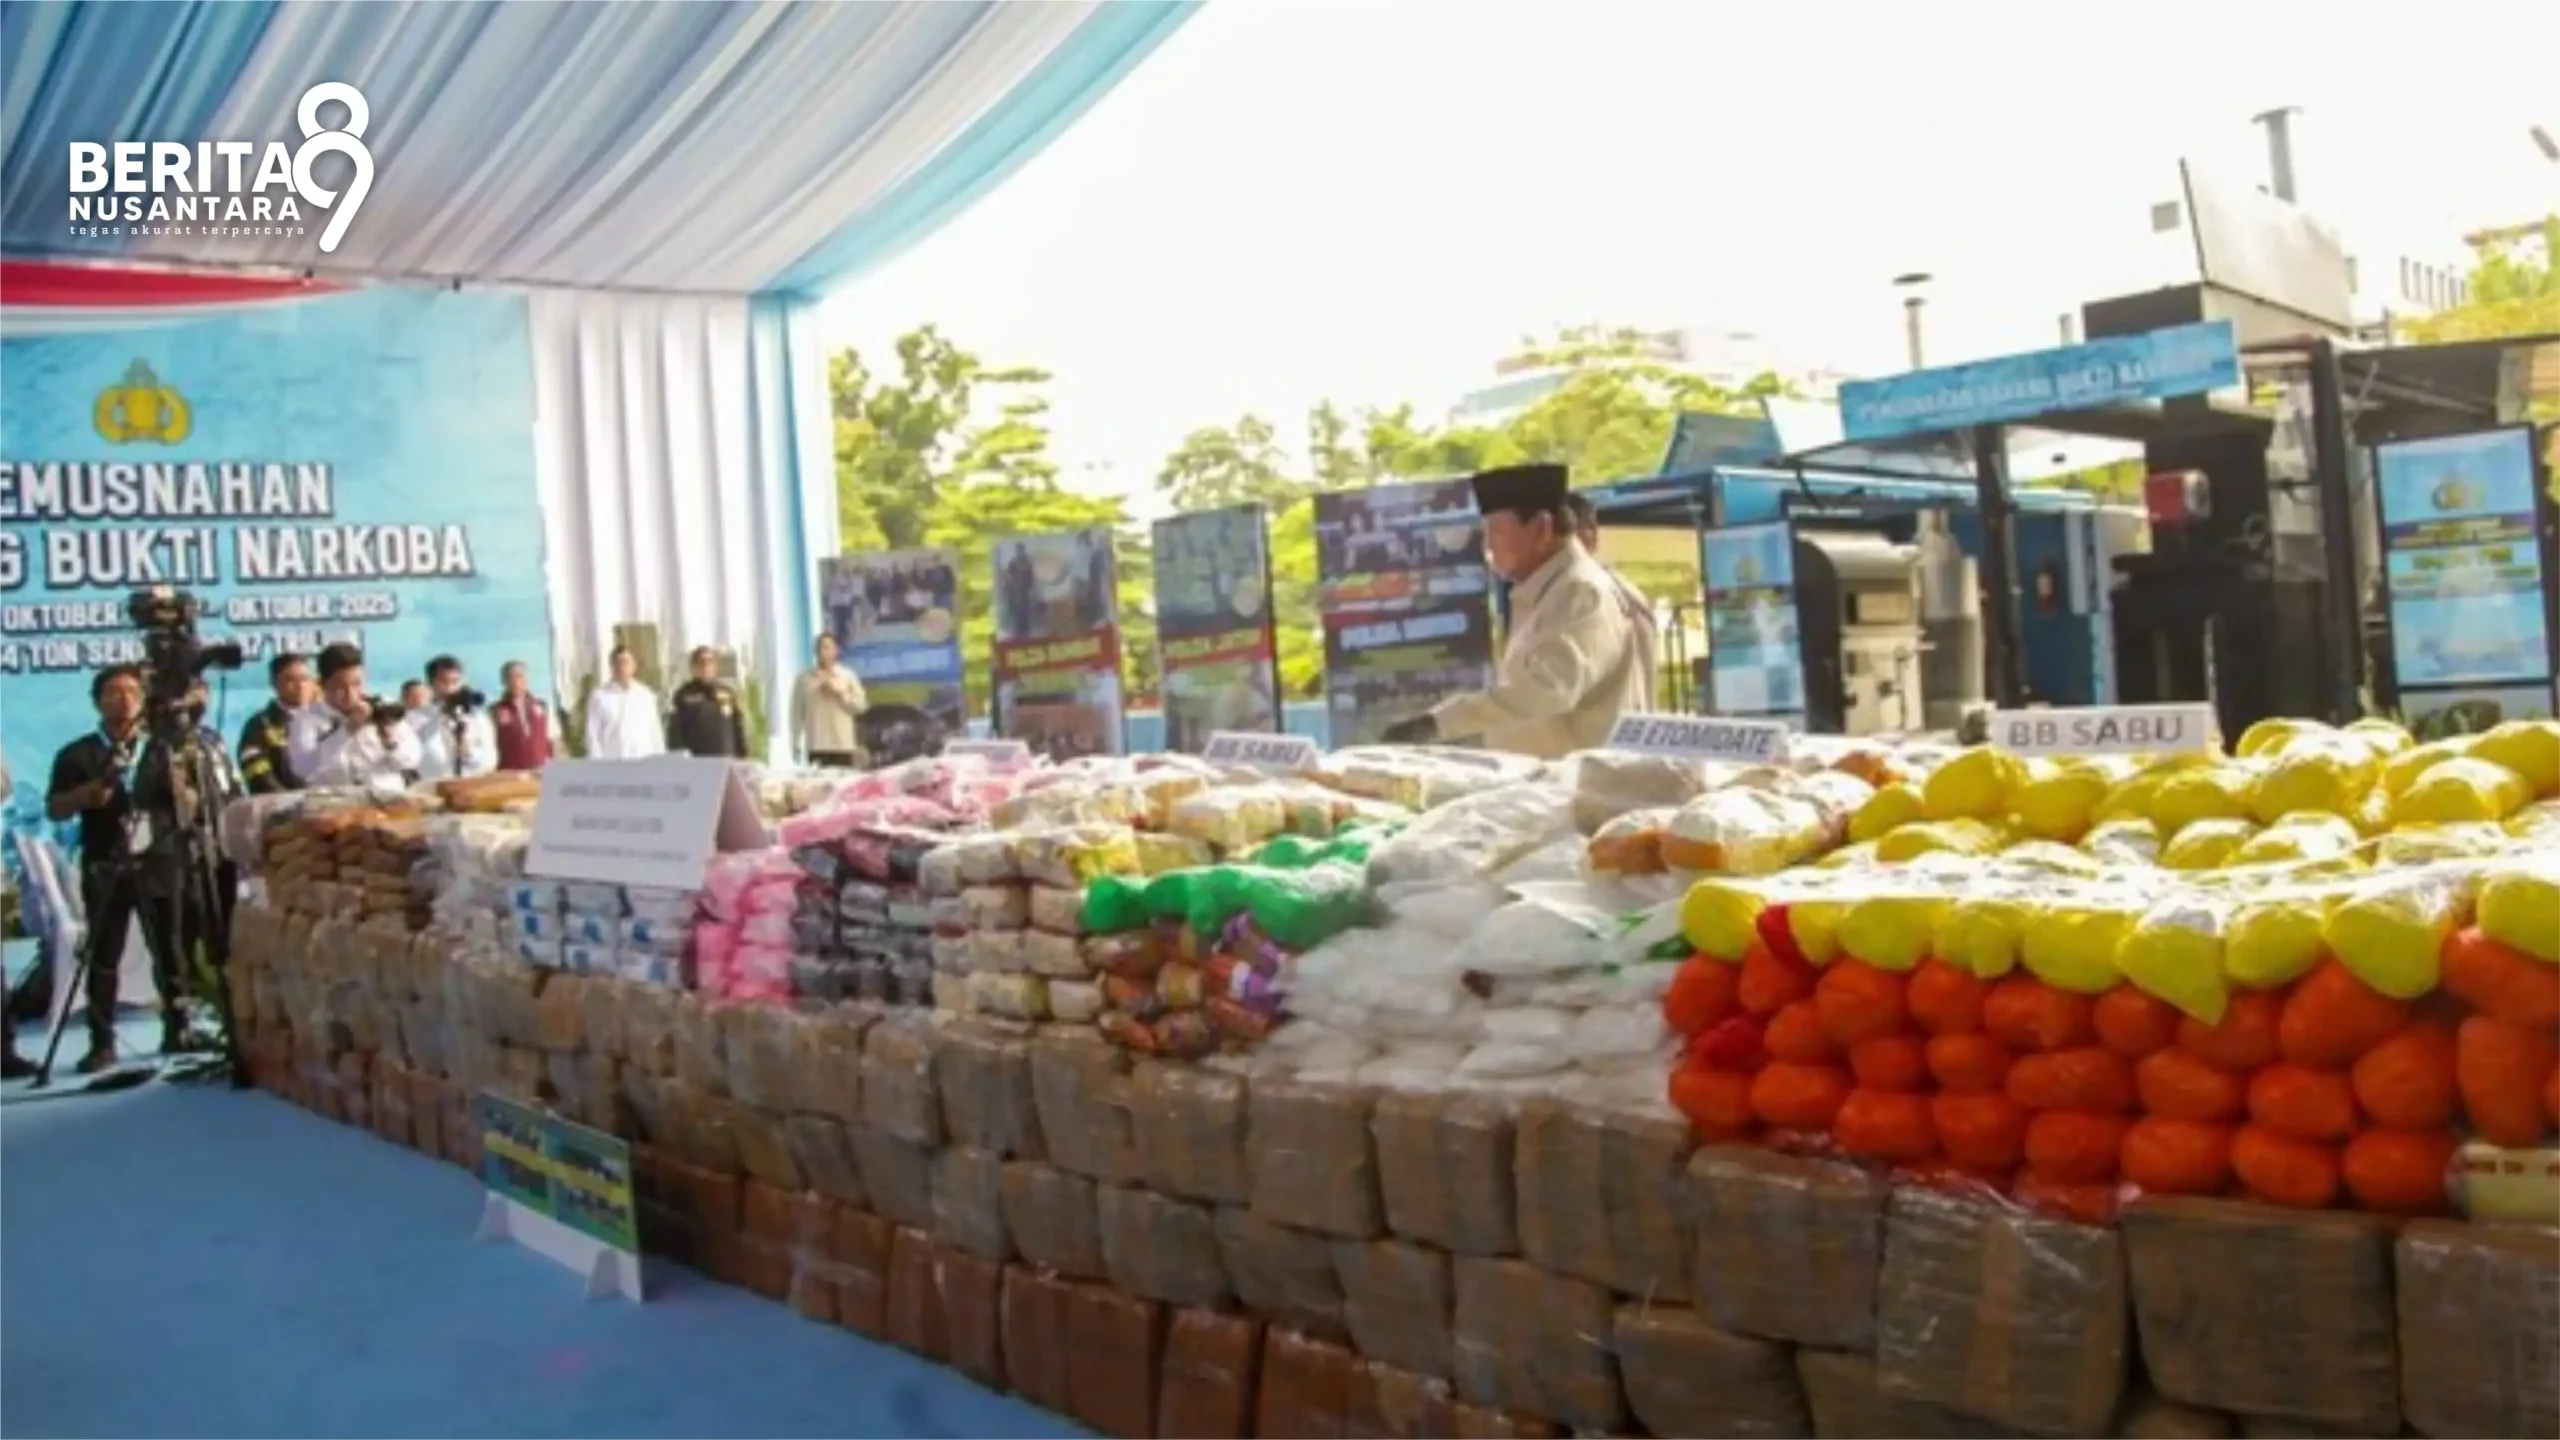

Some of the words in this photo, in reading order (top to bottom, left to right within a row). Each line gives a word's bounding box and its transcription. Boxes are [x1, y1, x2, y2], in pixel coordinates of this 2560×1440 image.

[48, 529, 216, 583] BUKTI
[237, 525, 472, 577] NARKOBA
[4, 601, 118, 630] OKTOBER
[228, 593, 330, 621] OKTOBER
[2008, 720, 2059, 747] BB
[2071, 715, 2184, 746] SABU
